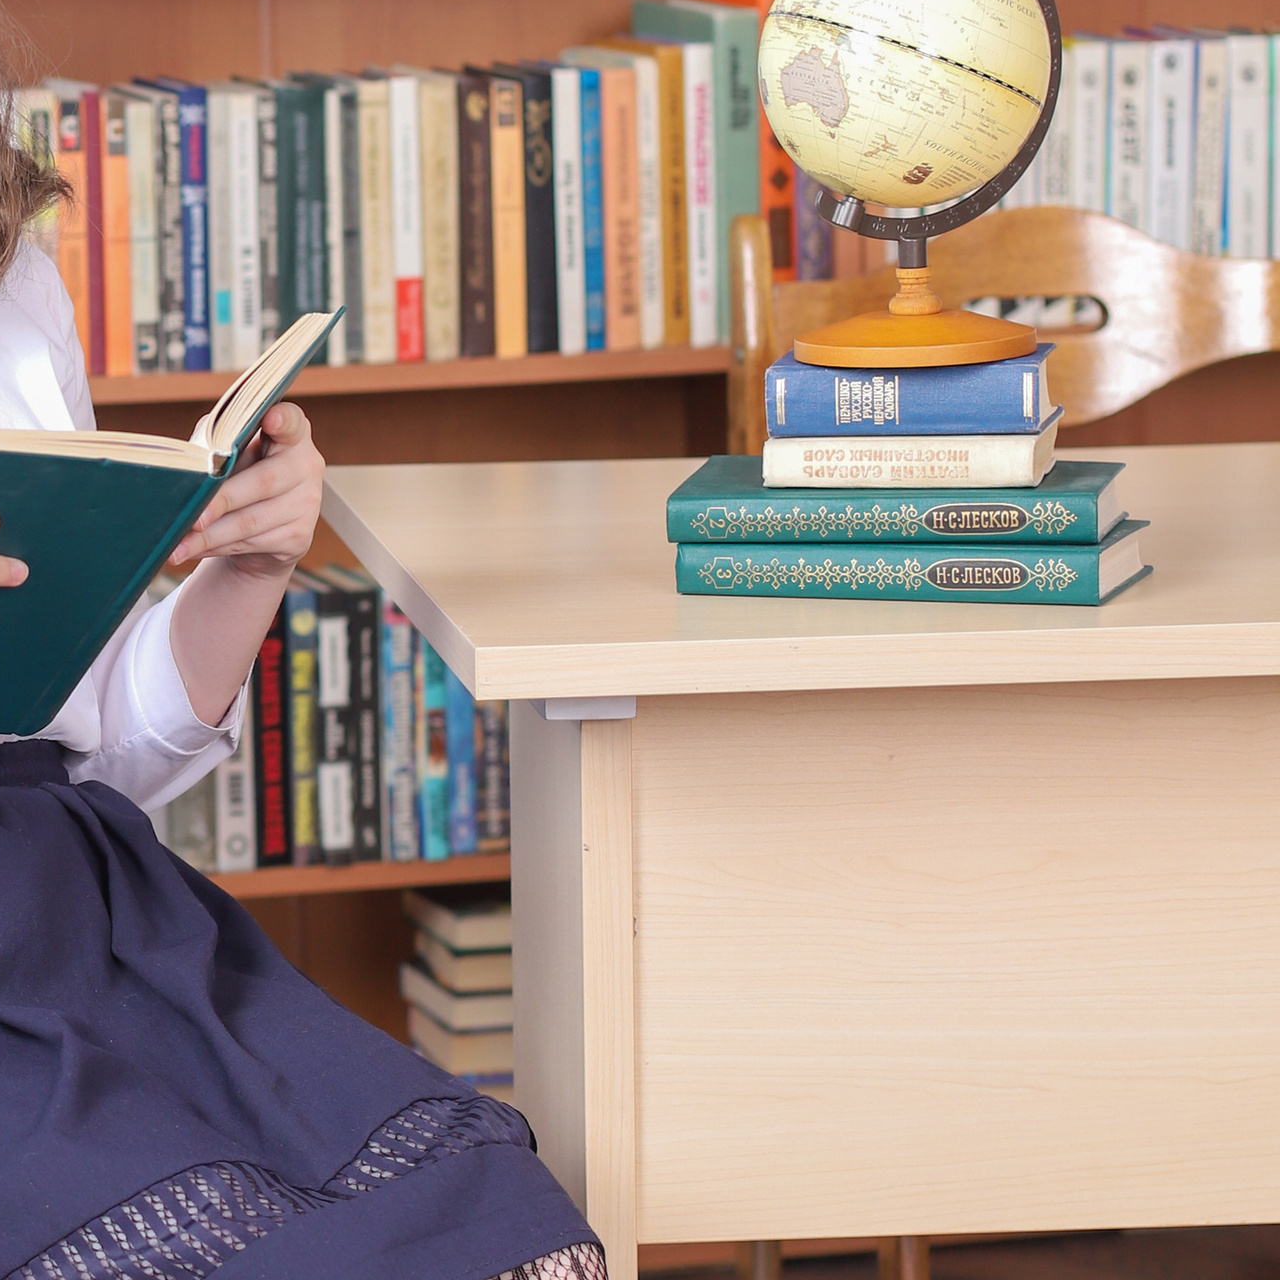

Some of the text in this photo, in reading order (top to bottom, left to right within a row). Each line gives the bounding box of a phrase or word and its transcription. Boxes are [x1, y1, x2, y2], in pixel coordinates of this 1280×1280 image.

[790, 70, 829, 85] AUSTRALIA
[845, 73, 920, 102] OCEANIA
[924, 139, 957, 158] SOUTH
[839, 378, 851, 424] НЕМЕЦКО-
[850, 380, 862, 422] РУССКИЙ
[862, 381, 873, 419] РУССКО-
[871, 376, 885, 425] НЕМЕЦКИЙ
[884, 381, 895, 420] СЛОВАРЬ
[803, 449, 970, 463] ИНОСТРАННЫХ СЛОВ
[802, 465, 970, 482] КРАТКИЙ СЛОВАРЬ
[709, 518, 726, 529] 2
[716, 568, 732, 579] 3
